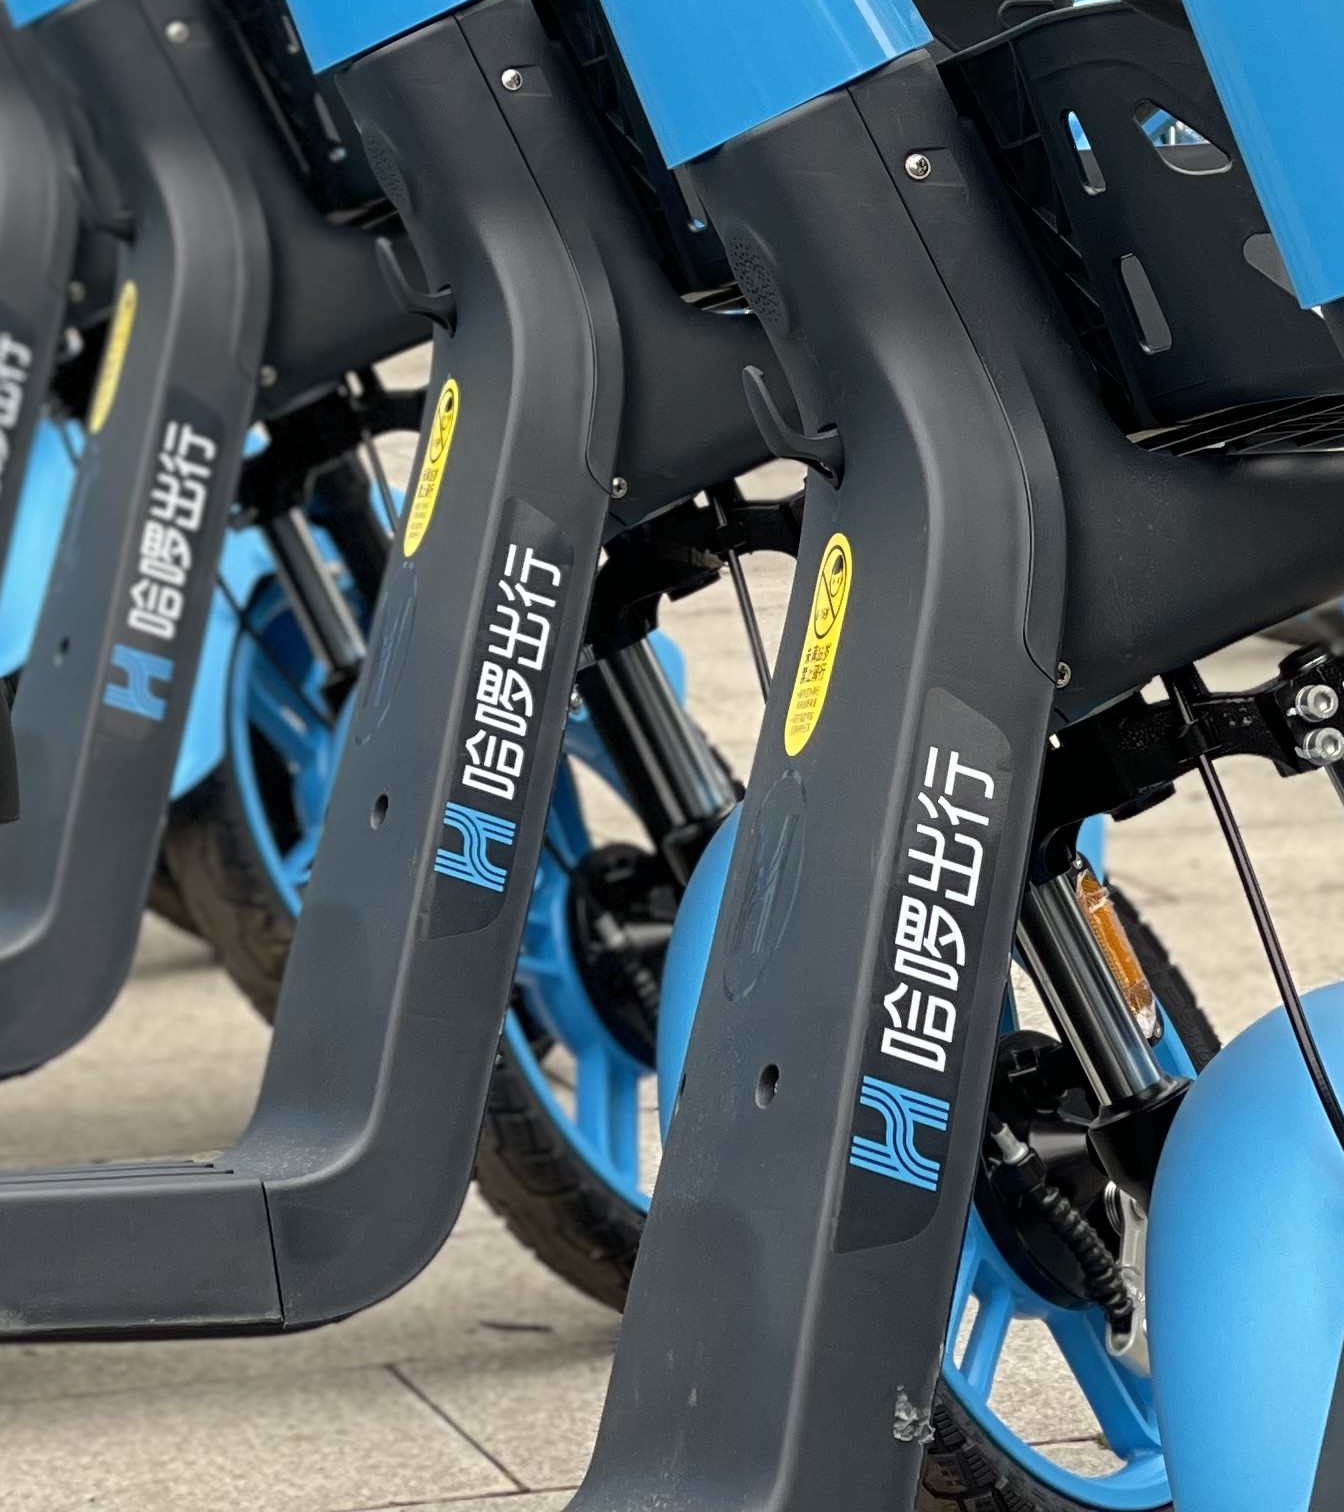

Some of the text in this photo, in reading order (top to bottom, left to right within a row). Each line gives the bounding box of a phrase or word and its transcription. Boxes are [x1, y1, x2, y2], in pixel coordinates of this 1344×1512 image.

[127, 422, 220, 641] 哈啰出行
[462, 544, 563, 801] 哈啰出行
[880, 746, 999, 1073] 哈啰出行
